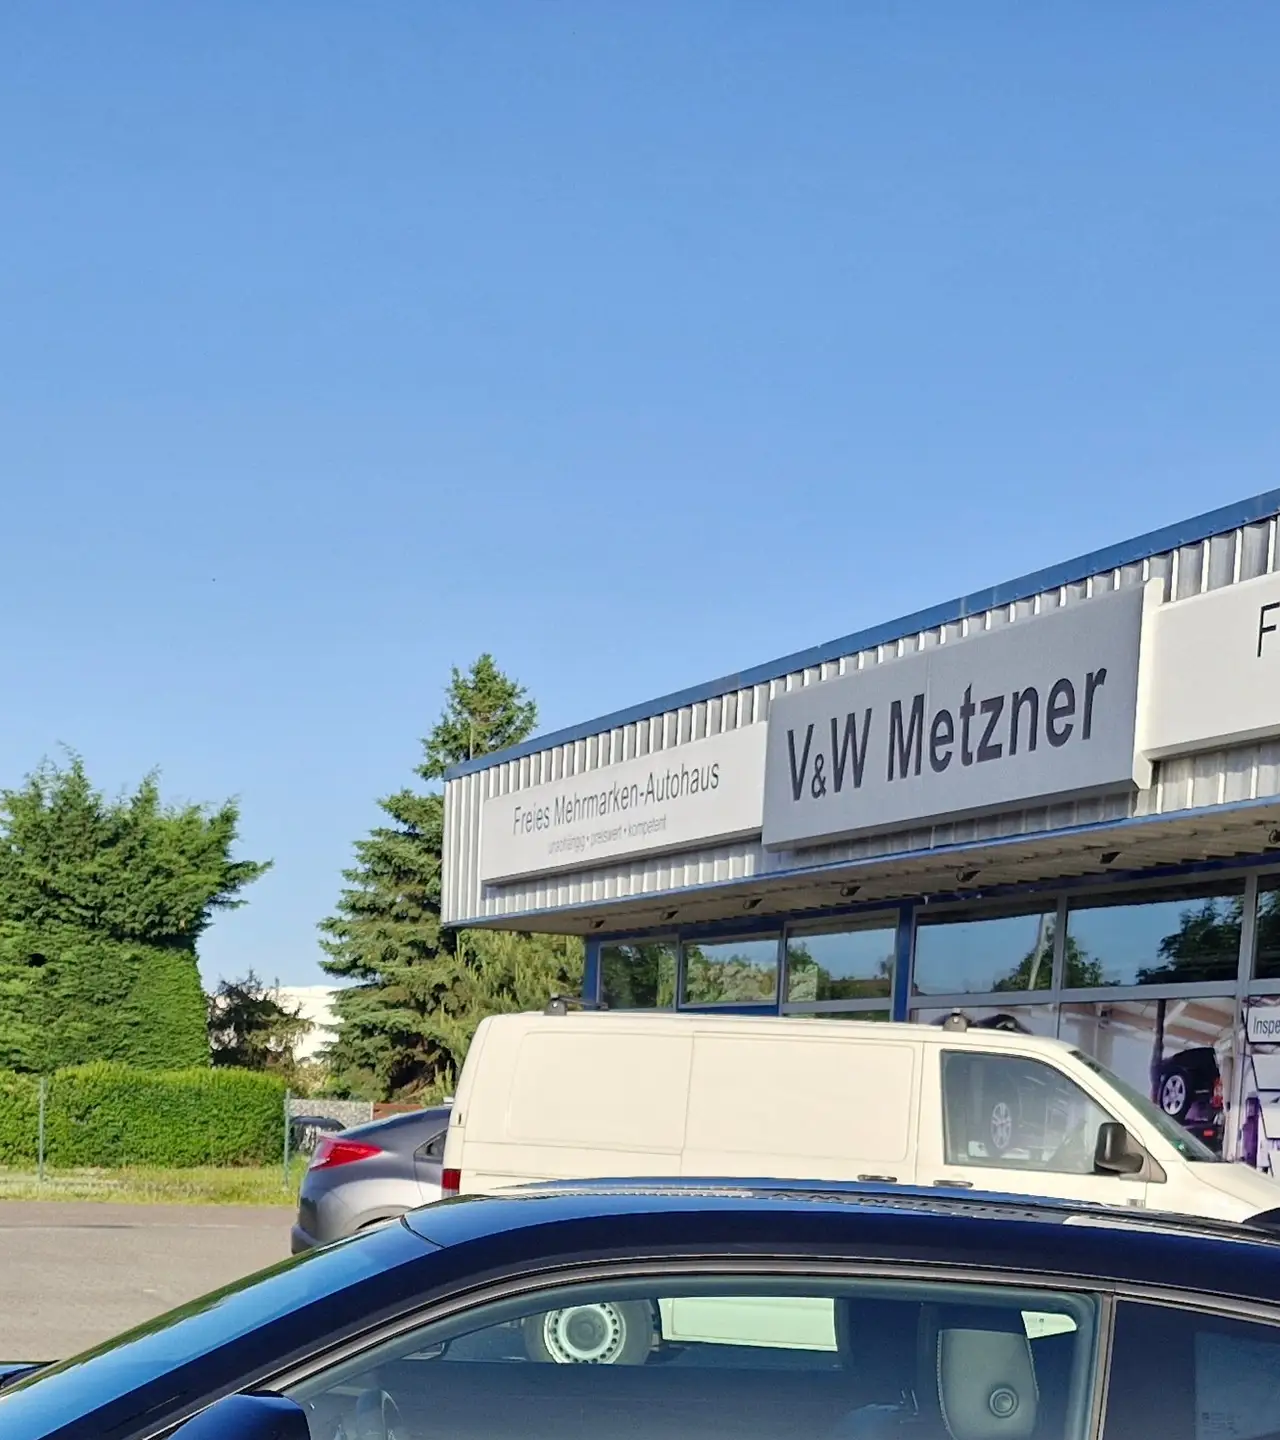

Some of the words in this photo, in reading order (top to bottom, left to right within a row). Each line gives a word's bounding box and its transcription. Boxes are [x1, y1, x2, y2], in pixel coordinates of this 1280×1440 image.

[786, 707, 873, 801] V&W
[887, 667, 1108, 782] Metzner
[513, 803, 550, 836] Freies
[554, 762, 720, 826] Mehrmarken-Autohaus
[628, 814, 667, 837] kompetent
